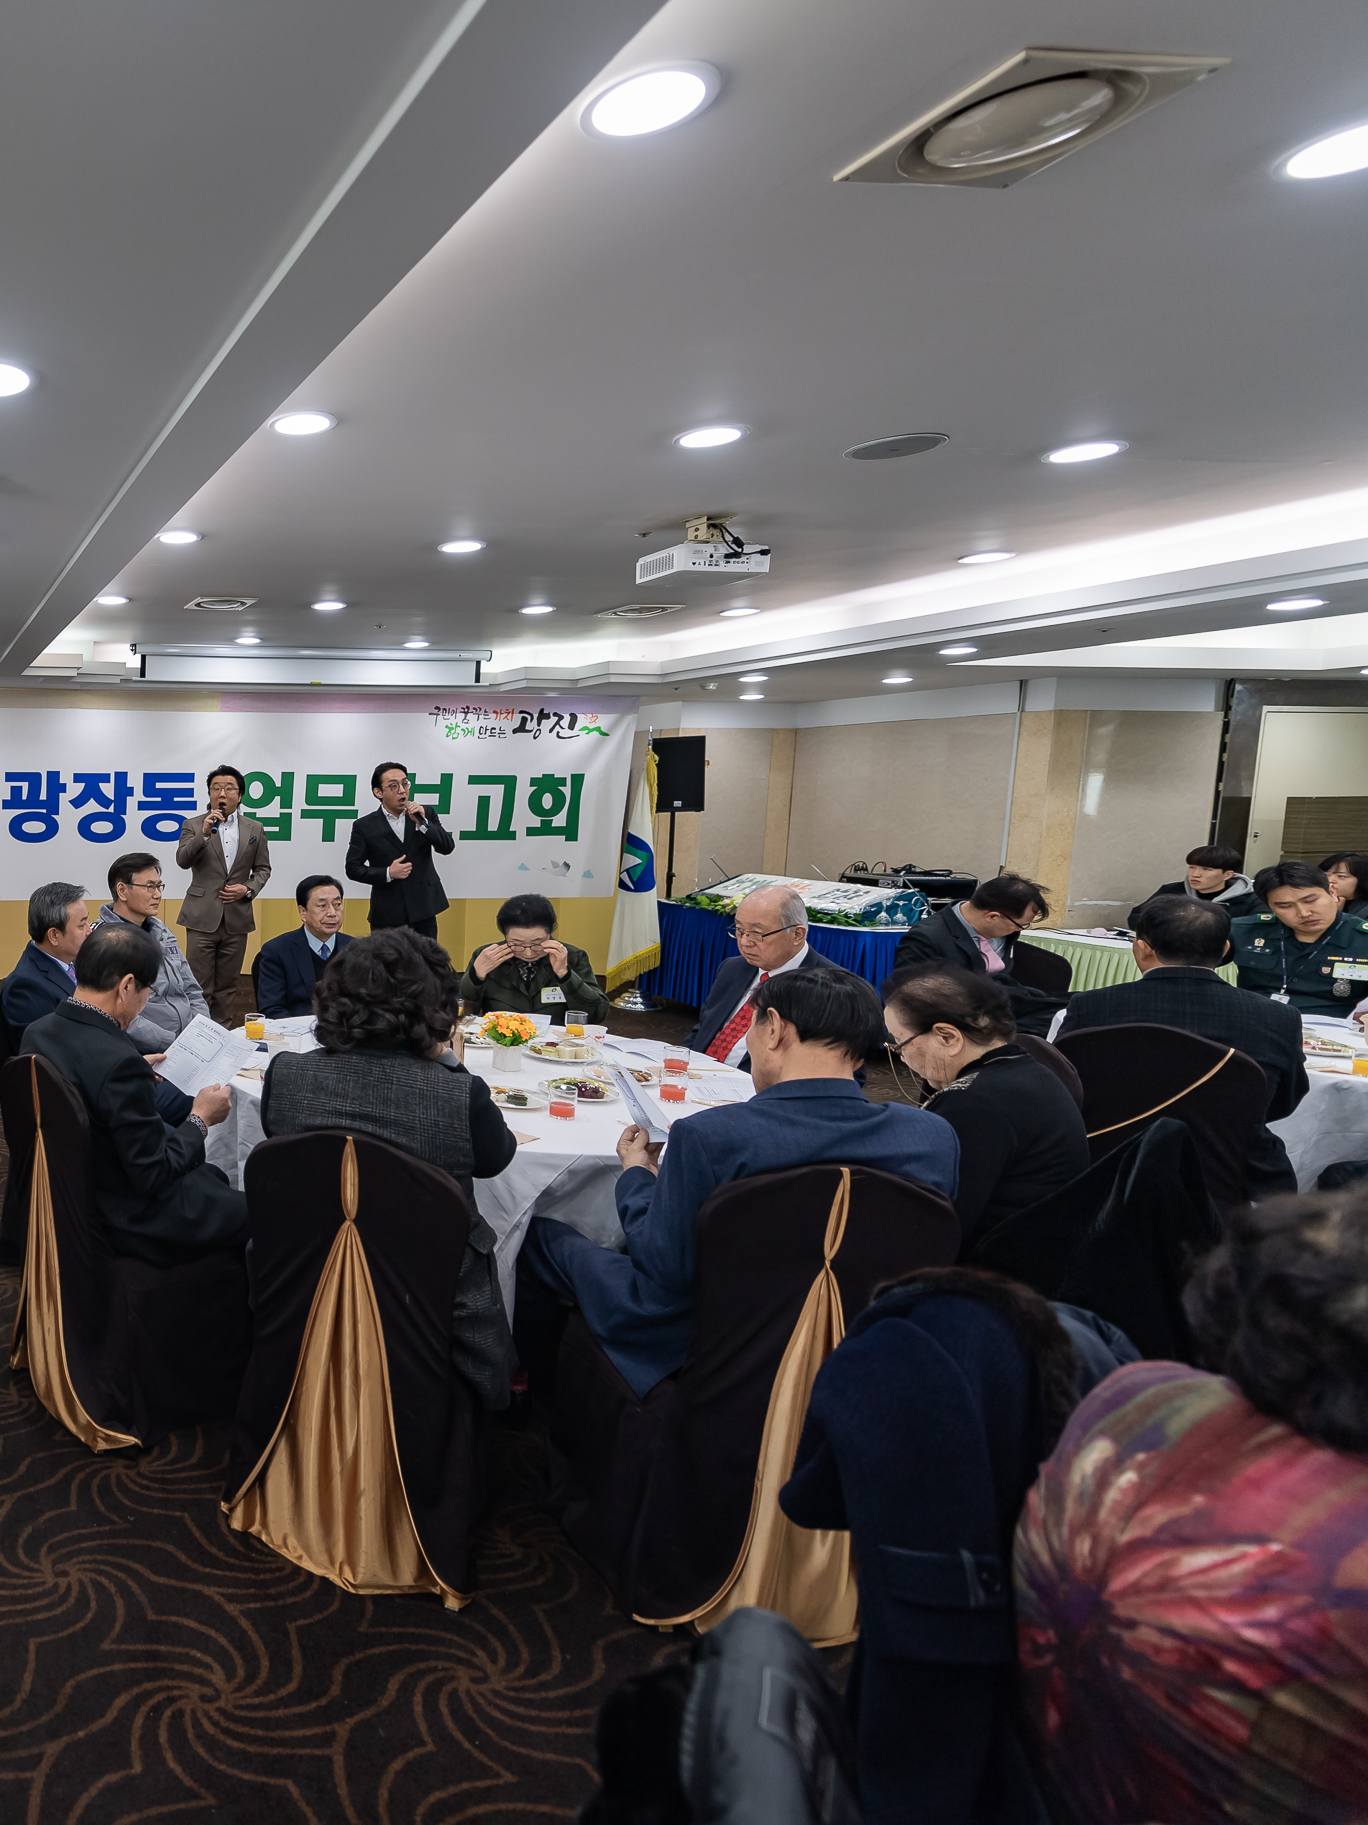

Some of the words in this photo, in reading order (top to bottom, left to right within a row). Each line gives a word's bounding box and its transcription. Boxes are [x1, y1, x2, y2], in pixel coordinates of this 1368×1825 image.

[492, 708, 515, 722] 가치
[512, 707, 580, 740] 광진
[445, 722, 475, 740] 함께
[2, 770, 198, 843] 광장동
[241, 771, 359, 842] 업무
